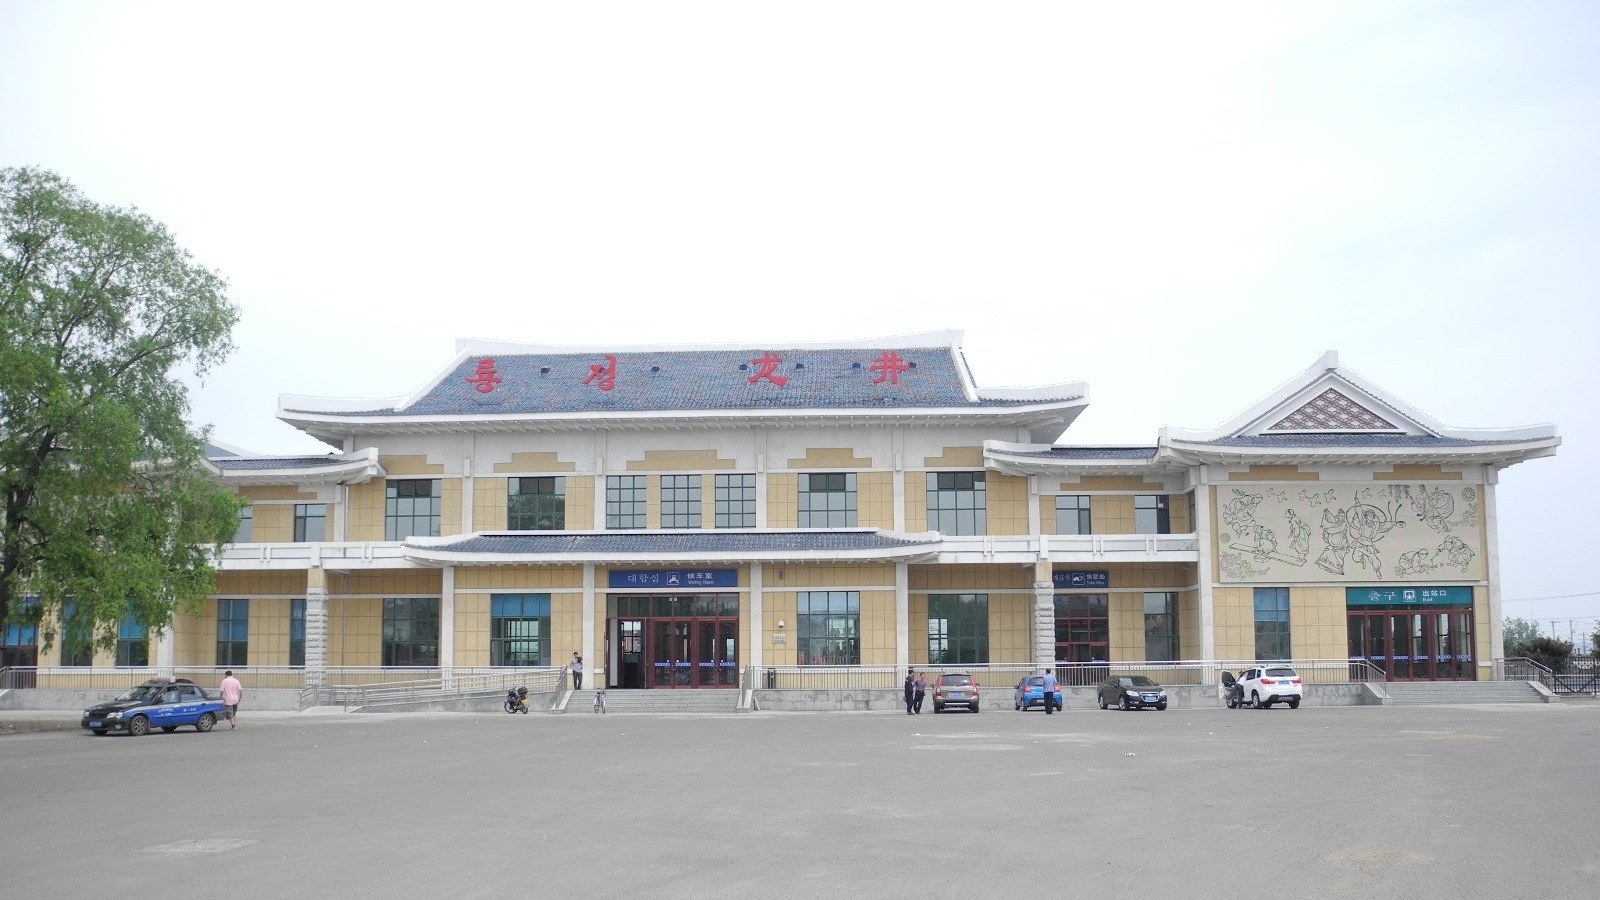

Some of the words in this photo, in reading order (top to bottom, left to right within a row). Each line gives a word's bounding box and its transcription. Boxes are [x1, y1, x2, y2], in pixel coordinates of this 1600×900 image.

[465, 354, 617, 394] 룡정
[747, 351, 911, 386] 龙井
[686, 572, 713, 580] 候车室
[1422, 589, 1447, 597] 出站口
